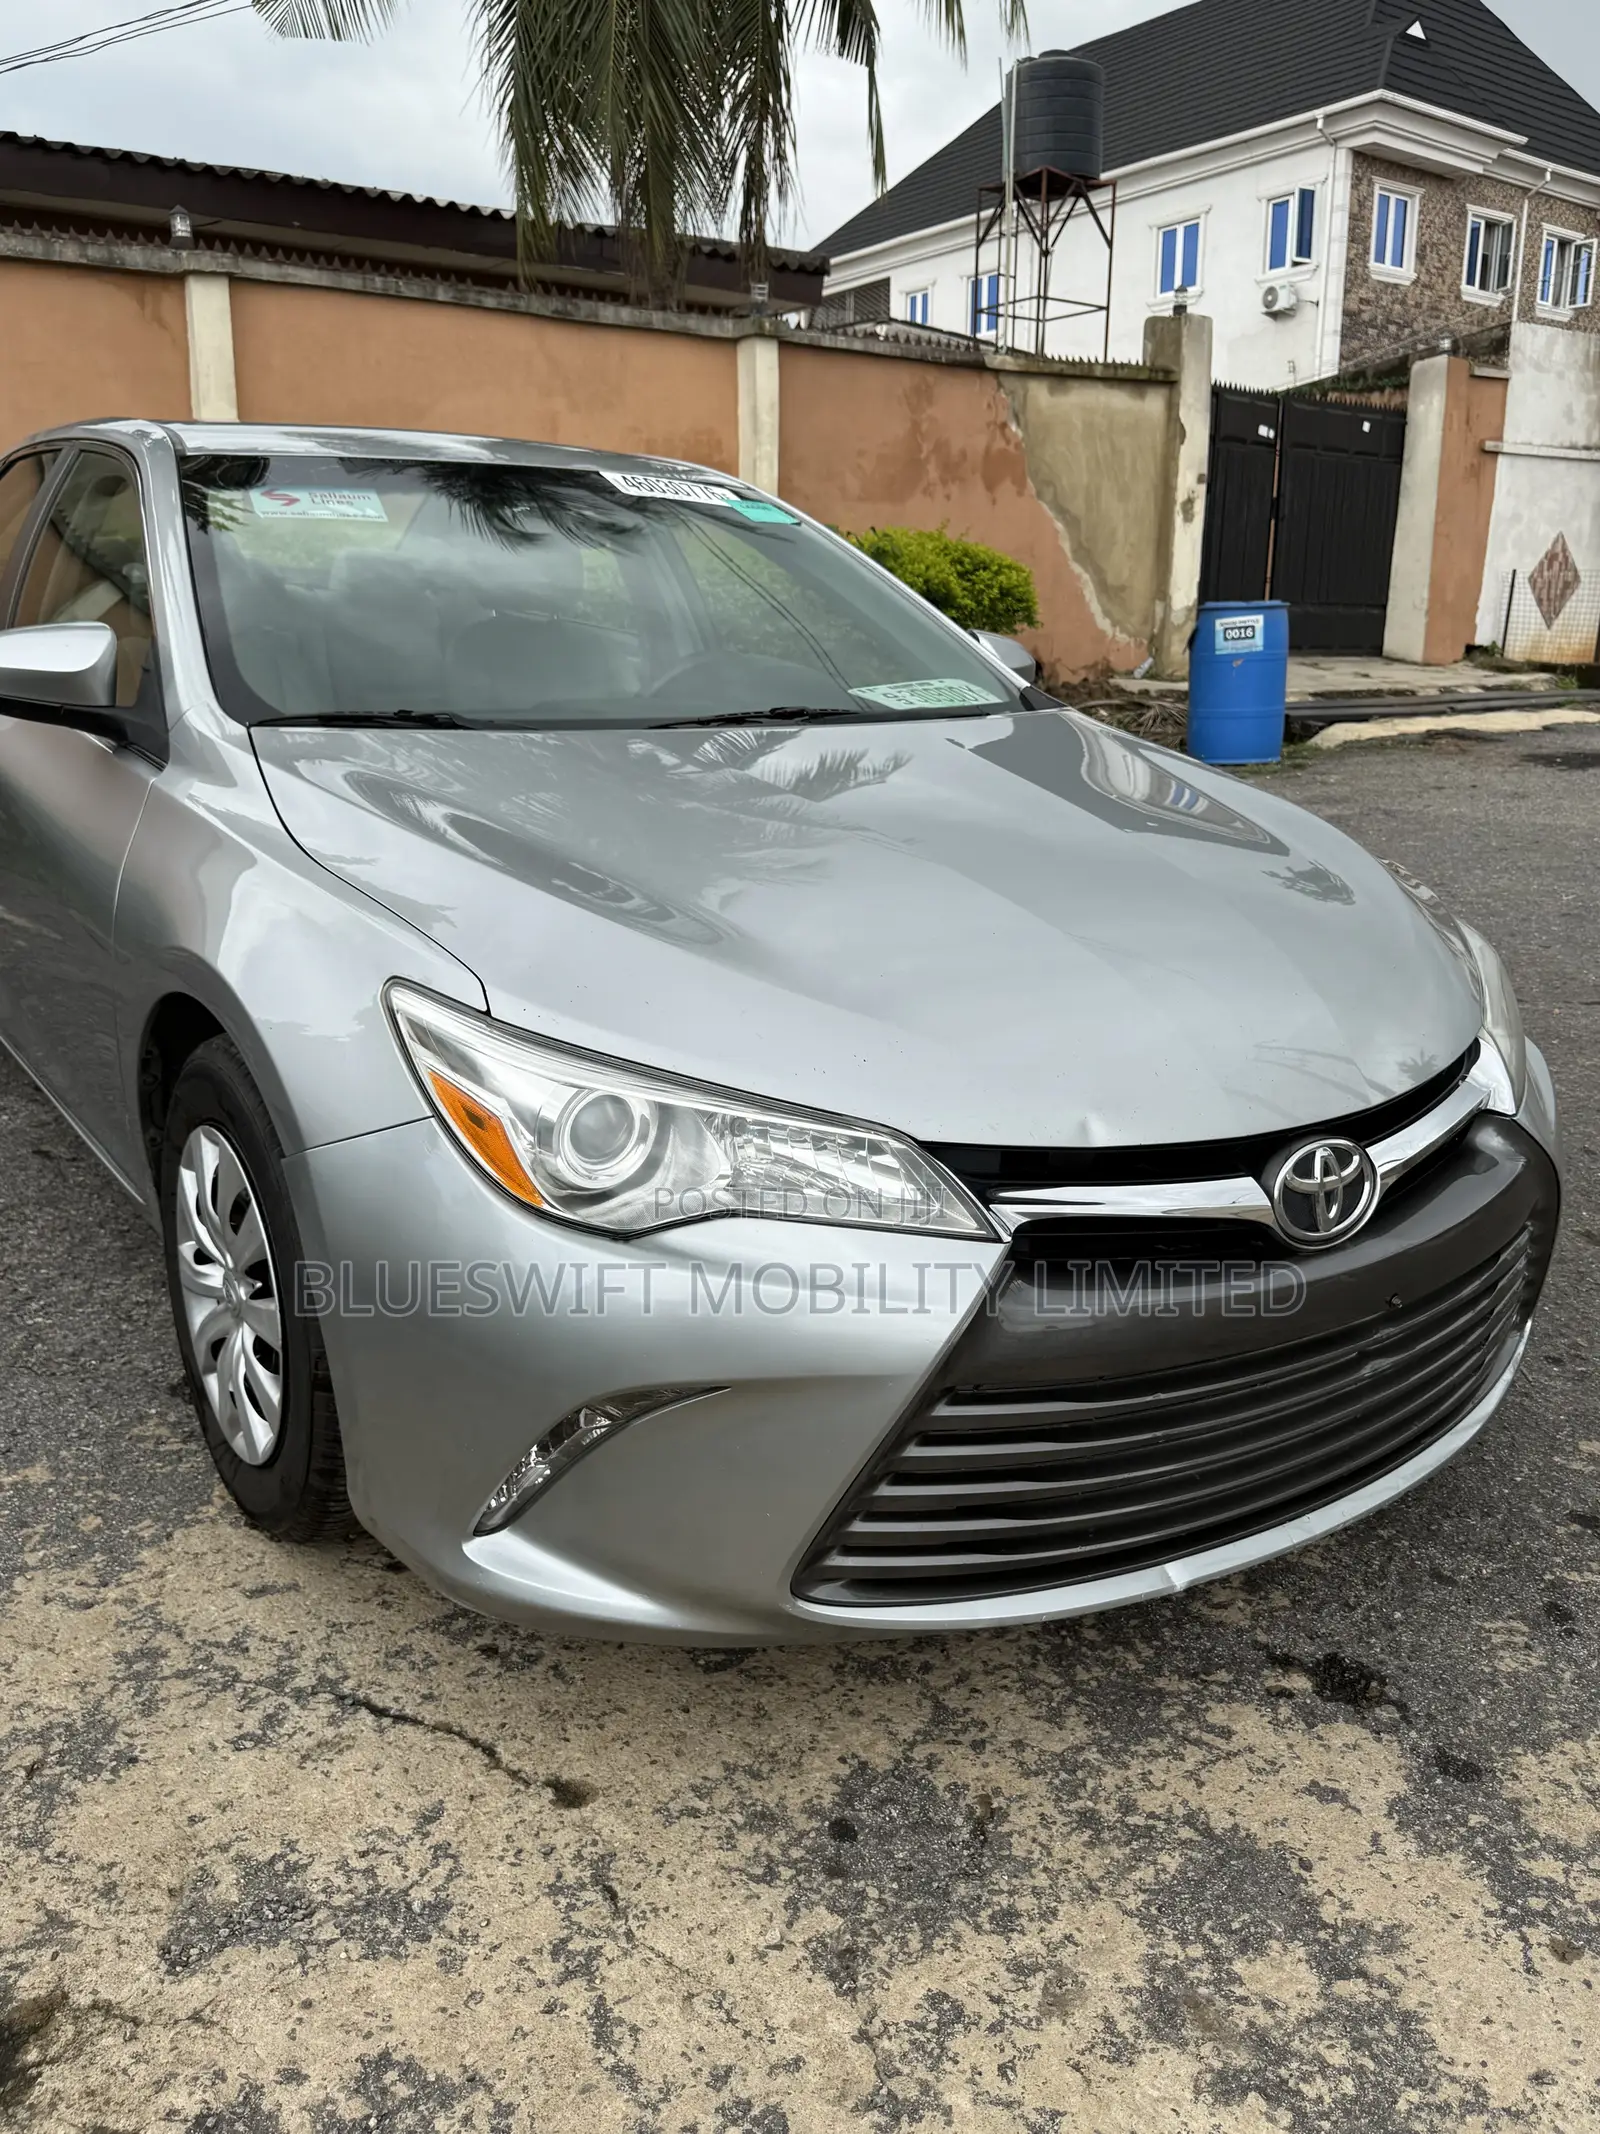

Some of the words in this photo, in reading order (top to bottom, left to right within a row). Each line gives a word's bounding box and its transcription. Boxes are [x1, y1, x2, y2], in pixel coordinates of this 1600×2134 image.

[308, 491, 372, 501] Sallaum
[311, 499, 355, 507] Lines
[1225, 626, 1254, 640] 0016
